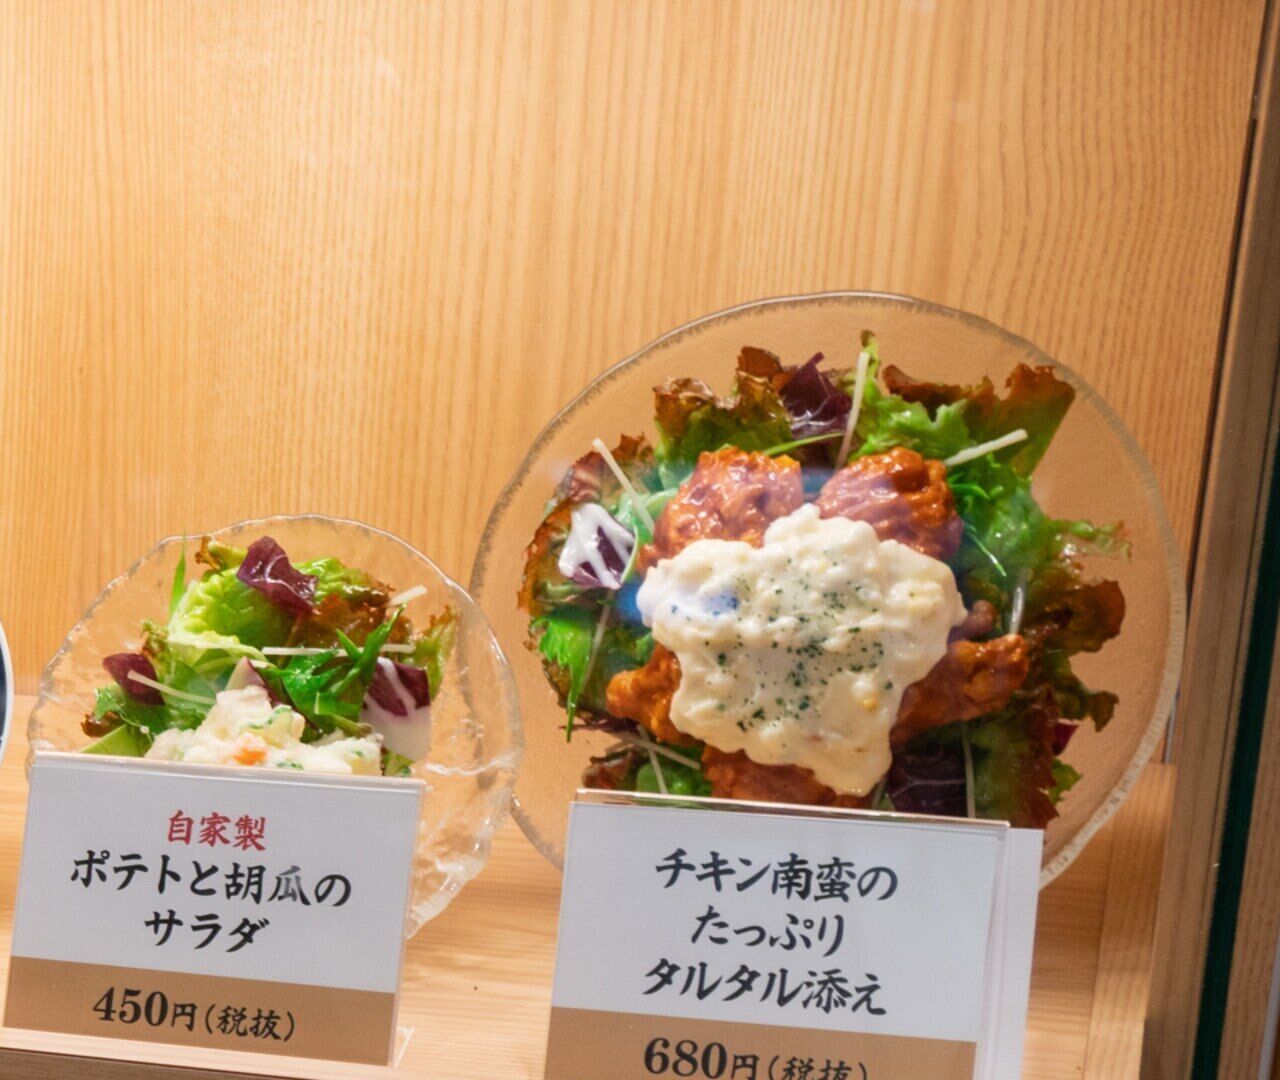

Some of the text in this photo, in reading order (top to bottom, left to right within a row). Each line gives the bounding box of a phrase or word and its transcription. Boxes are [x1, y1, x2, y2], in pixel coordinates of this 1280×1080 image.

[167, 809, 267, 851] 自家製
[70, 849, 352, 907] ポテトと胡瓜の
[655, 847, 898, 902] チキン南蛮の
[143, 909, 270, 953] サラダ
[690, 904, 845, 957] たっぷり
[92, 986, 295, 1042] 450円（税抜）
[642, 957, 887, 1016] タルタル添え
